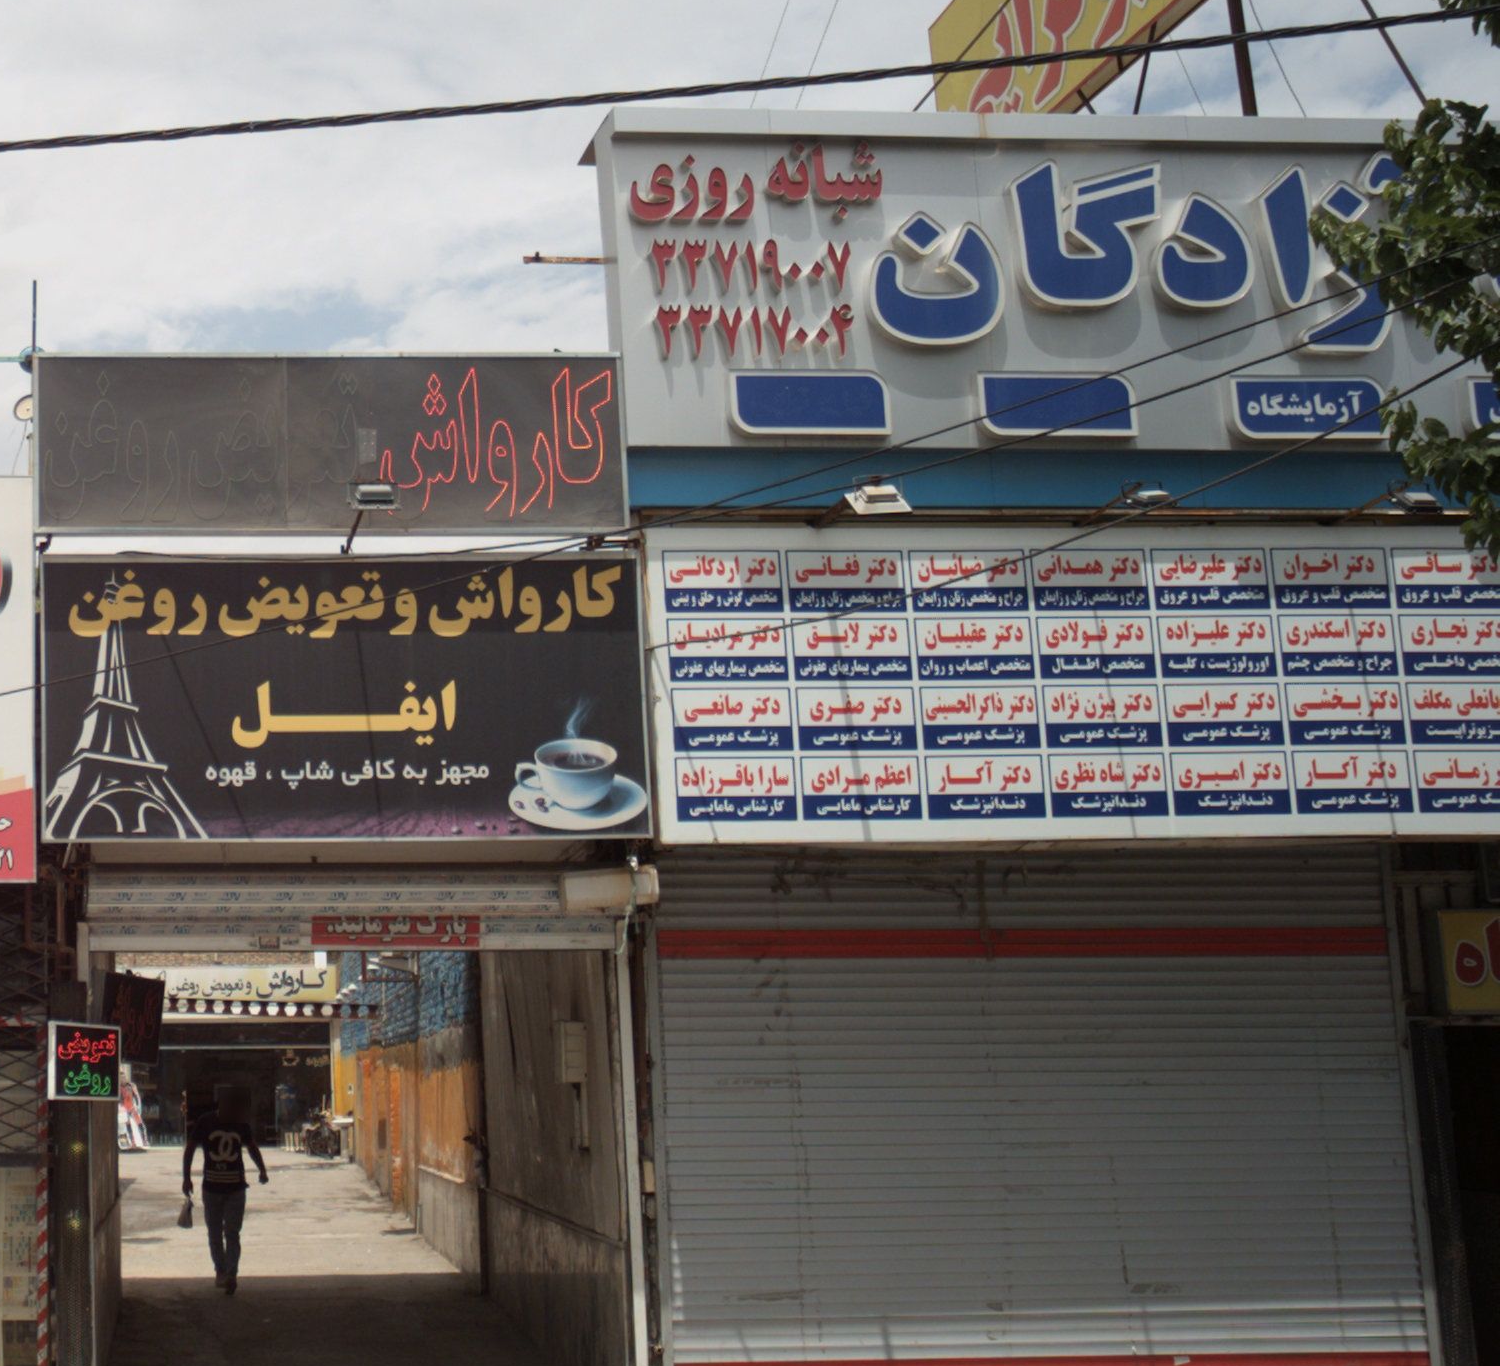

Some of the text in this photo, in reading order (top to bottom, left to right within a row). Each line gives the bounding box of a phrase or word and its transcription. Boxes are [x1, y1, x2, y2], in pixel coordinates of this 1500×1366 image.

[630, 154, 755, 221] روزی
[767, 141, 883, 221] شبانه
[650, 238, 852, 292] ۳۳۷۱۹۰۰۷
[656, 303, 855, 357] ۳۳۷۱۷۰۰۴
[1245, 389, 1364, 423] آزمایشگاه
[670, 556, 776, 584] دکتر اردکانی
[866, 558, 896, 583] دکتر
[1108, 557, 1139, 582] دکتر
[1231, 556, 1263, 581] دکتر
[1284, 555, 1374, 580] دکتر اخوان
[68, 565, 622, 640] کارواش و تعویض روغن
[807, 623, 898, 649] دکتر لایق
[994, 624, 1023, 649] دکتر
[1046, 622, 1145, 650] دکتر فولادی
[1166, 621, 1266, 647] دکتر علیزاده
[1287, 619, 1386, 647] دکتر اسکندری
[1412, 620, 1468, 646] نجاری
[748, 661, 785, 677] متخصص
[871, 660, 907, 676] متخصص
[991, 659, 1031, 675] متخصص
[1052, 657, 1145, 674] متخصص اطفال
[230, 679, 457, 749] ایفل
[751, 698, 780, 722] دکتر
[872, 697, 902, 722] دکتر
[1008, 694, 1035, 721] دکتر
[1123, 694, 1152, 719] دکتر
[1245, 693, 1275, 717] دکتر
[1294, 691, 1399, 718] دکتر بخشی
[689, 730, 779, 746] پزشک عمومی
[813, 729, 902, 745] پزشک عمومی
[937, 728, 1025, 745] پزشک عمومی
[1060, 726, 1148, 743] پزشک عمومی
[1183, 725, 1270, 741] پزشک عمومی
[1304, 724, 1391, 740] پزشک عمومی
[204, 758, 490, 790] مجهز به کافی شاپ قهوه
[810, 765, 870, 793] مرادی
[1000, 765, 1032, 791] دکتر
[1130, 764, 1160, 790] دکتر
[1179, 762, 1282, 789] دکتر امیری
[1367, 762, 1396, 787] دکتر
[689, 799, 784, 817] کارشناس مامایی
[817, 798, 911, 815] کارشناس مامایی
[950, 796, 1026, 814] دندانپزشک
[1071, 795, 1146, 812] دندانپزشک
[1198, 793, 1273, 810] دندانپزشک
[1312, 792, 1399, 809] پزشک عمومی
[1432, 794, 1477, 808] عمومی
[416, 915, 468, 945] پارک
[167, 969, 327, 998] کارواش تعویض روغن
[57, 1030, 116, 1063] تعویض
[63, 1062, 113, 1096] روغن
